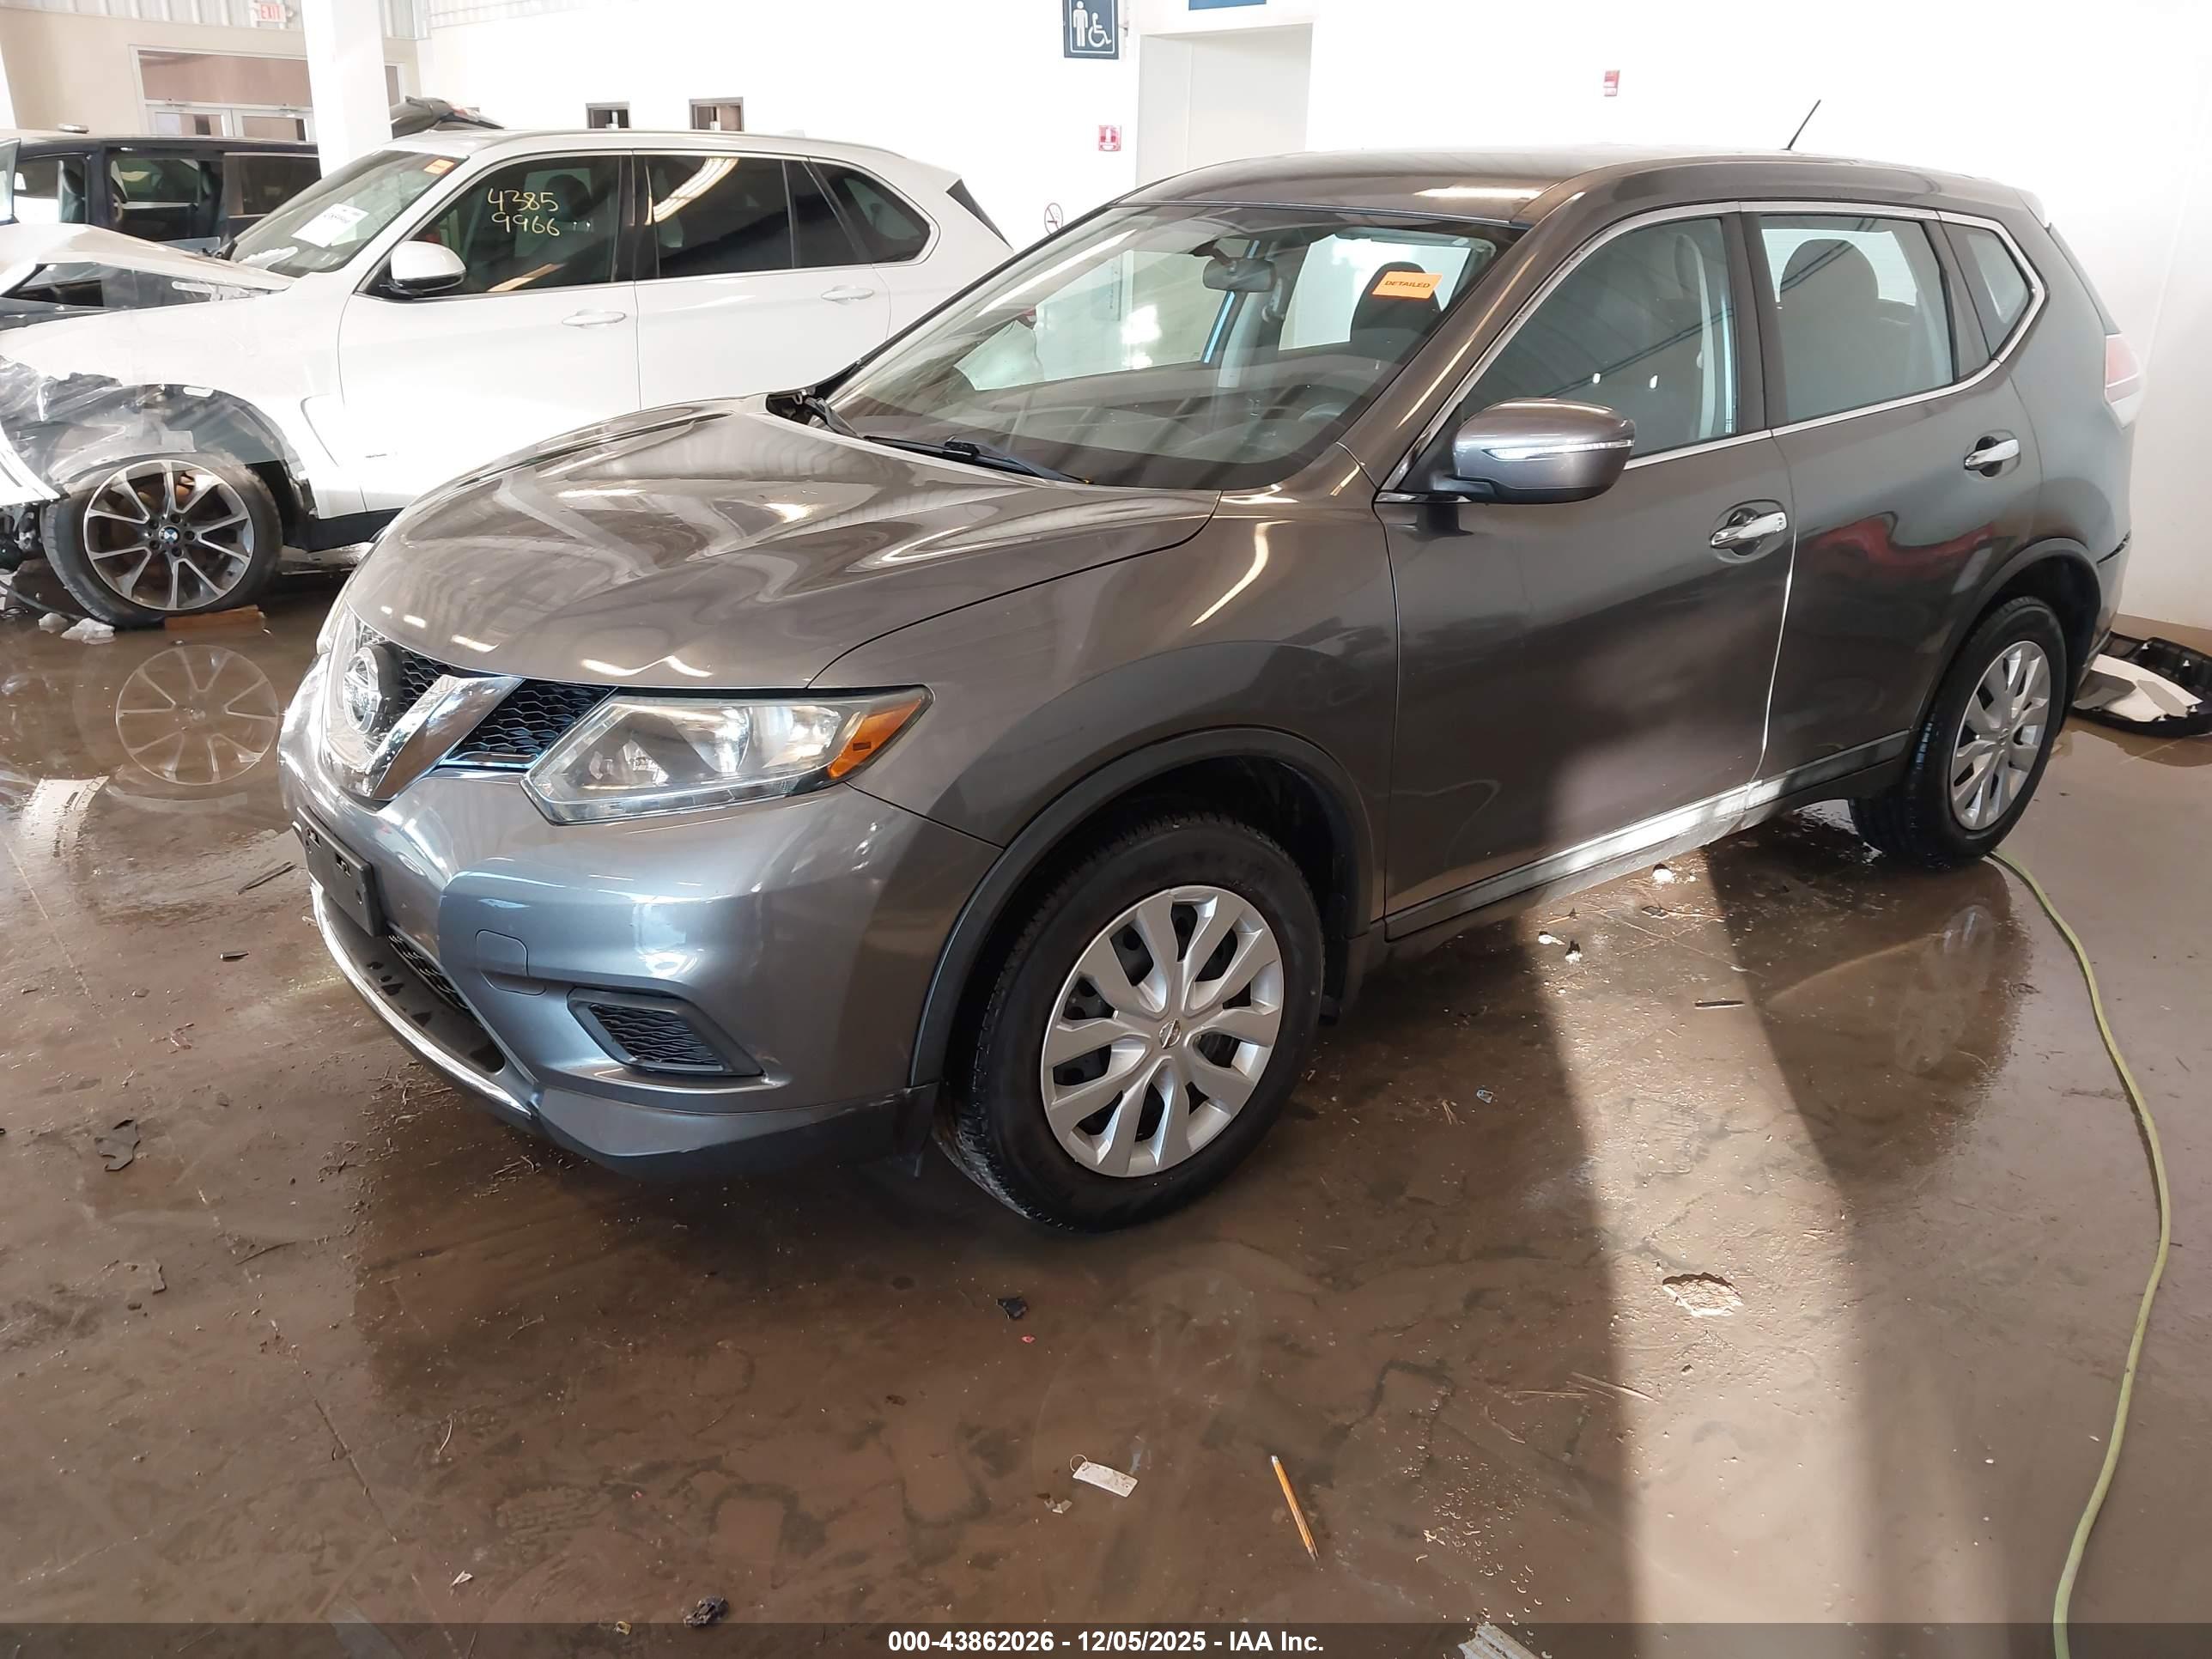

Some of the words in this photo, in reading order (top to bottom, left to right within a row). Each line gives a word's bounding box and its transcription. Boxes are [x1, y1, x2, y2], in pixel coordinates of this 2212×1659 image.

[260, 4, 282, 20] EXIT
[488, 187, 559, 211] 4385
[491, 212, 561, 236] 9966
[1384, 280, 1431, 289] DETAILED
